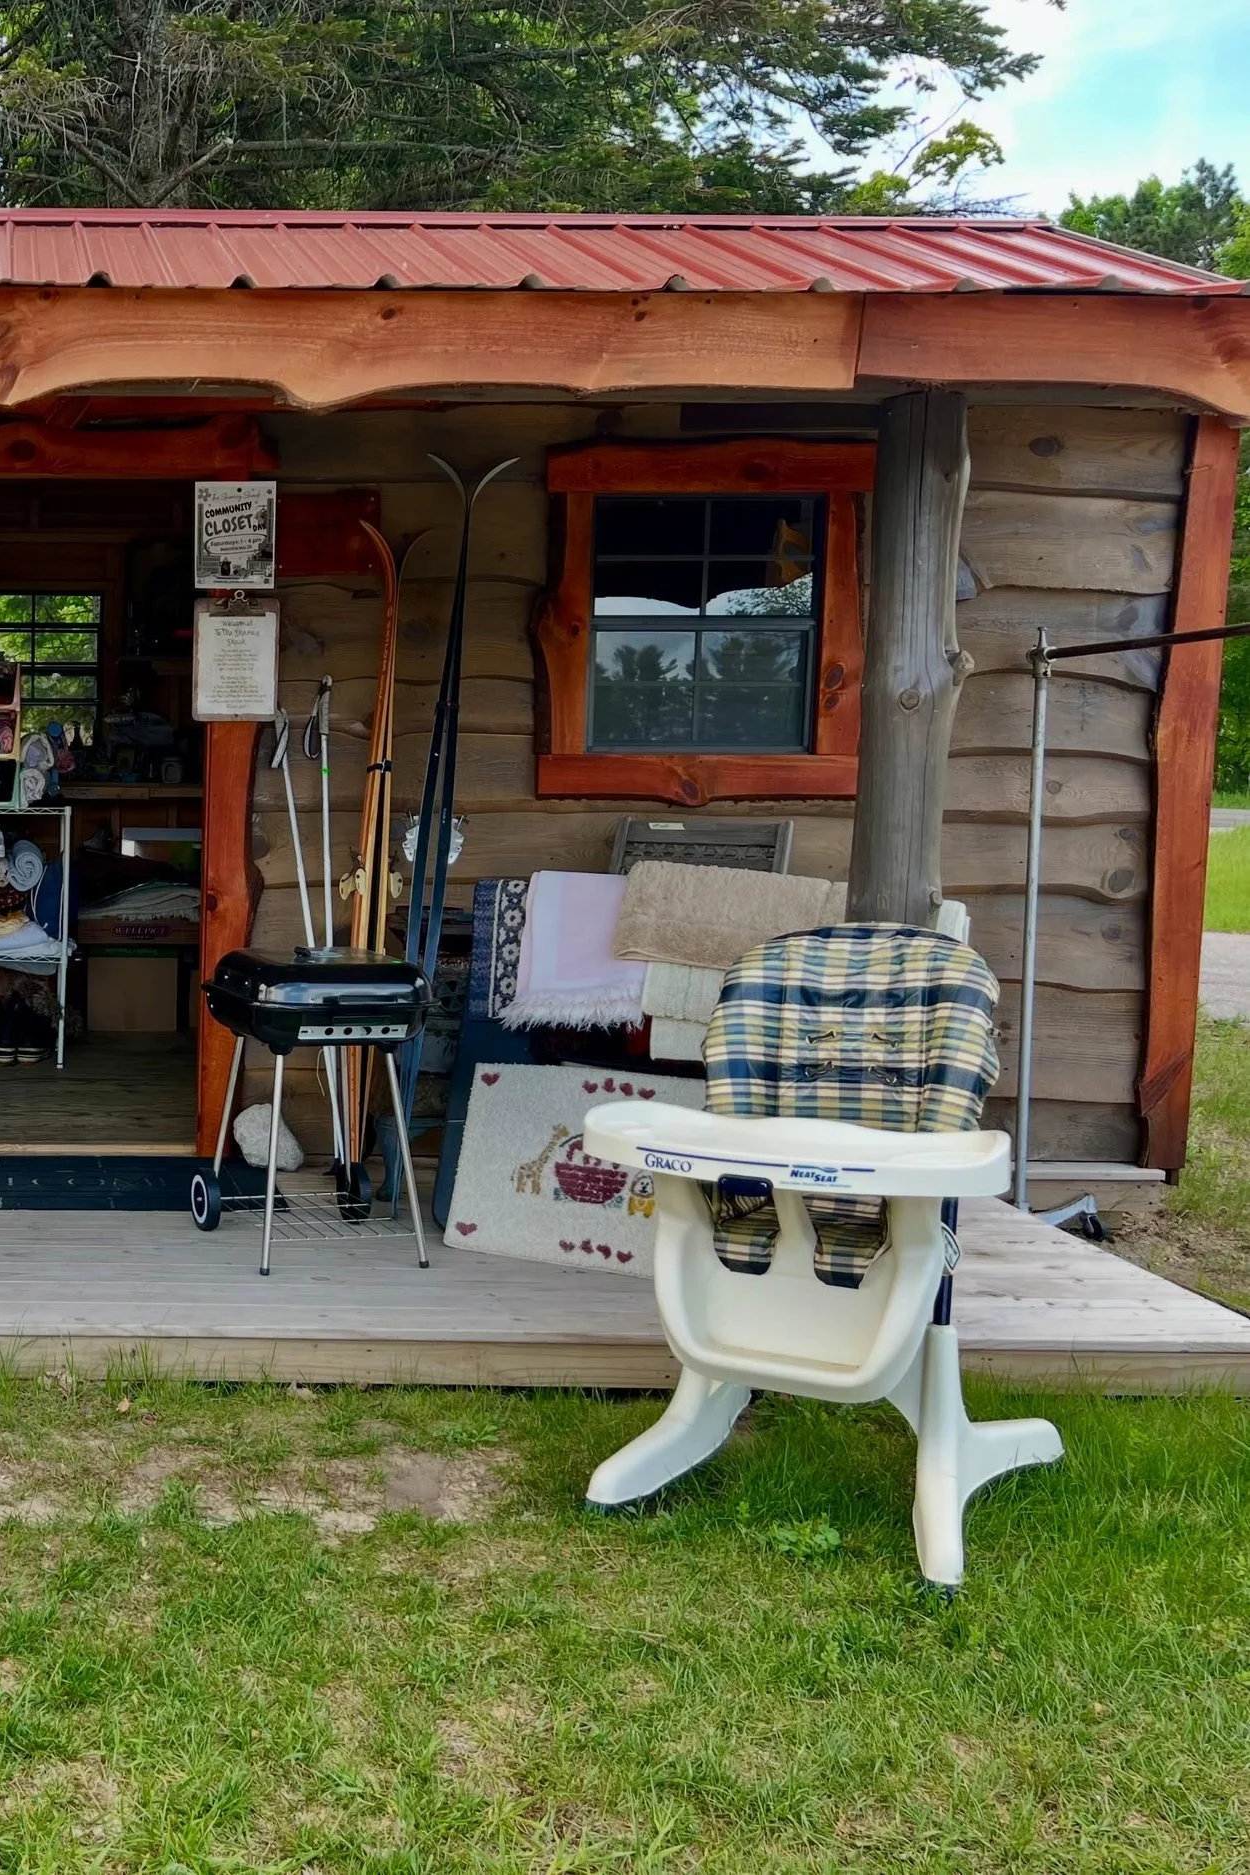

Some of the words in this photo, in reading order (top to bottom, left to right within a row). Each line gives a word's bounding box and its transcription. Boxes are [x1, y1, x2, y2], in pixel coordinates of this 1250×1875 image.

[205, 501, 252, 518] COMMUNITY
[205, 514, 253, 536] CLOSET
[645, 1153, 691, 1172] GRACO
